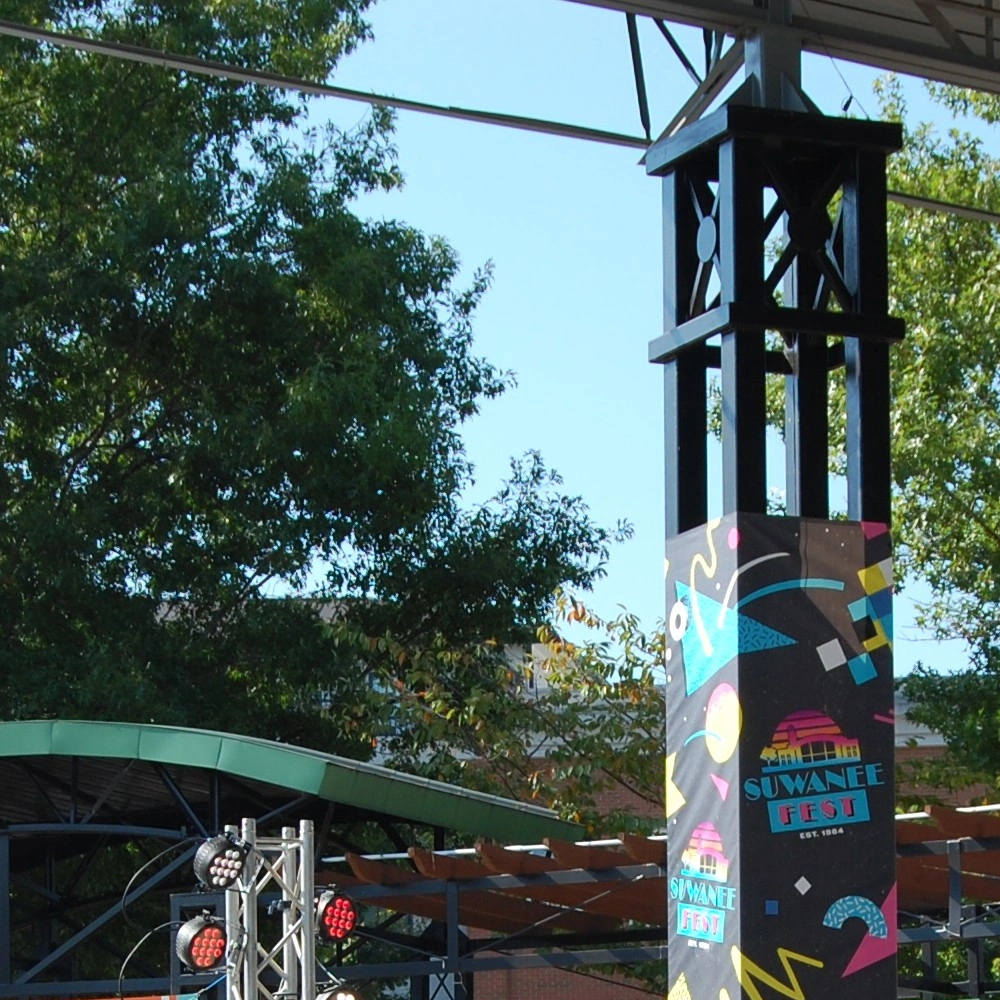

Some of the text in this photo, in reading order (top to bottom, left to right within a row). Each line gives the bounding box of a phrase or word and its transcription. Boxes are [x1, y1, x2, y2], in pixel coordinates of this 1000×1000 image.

[743, 762, 885, 801] SUWANEE
[778, 796, 859, 826] FEST
[670, 876, 737, 911] SUWANEE
[682, 908, 720, 936] FEST
